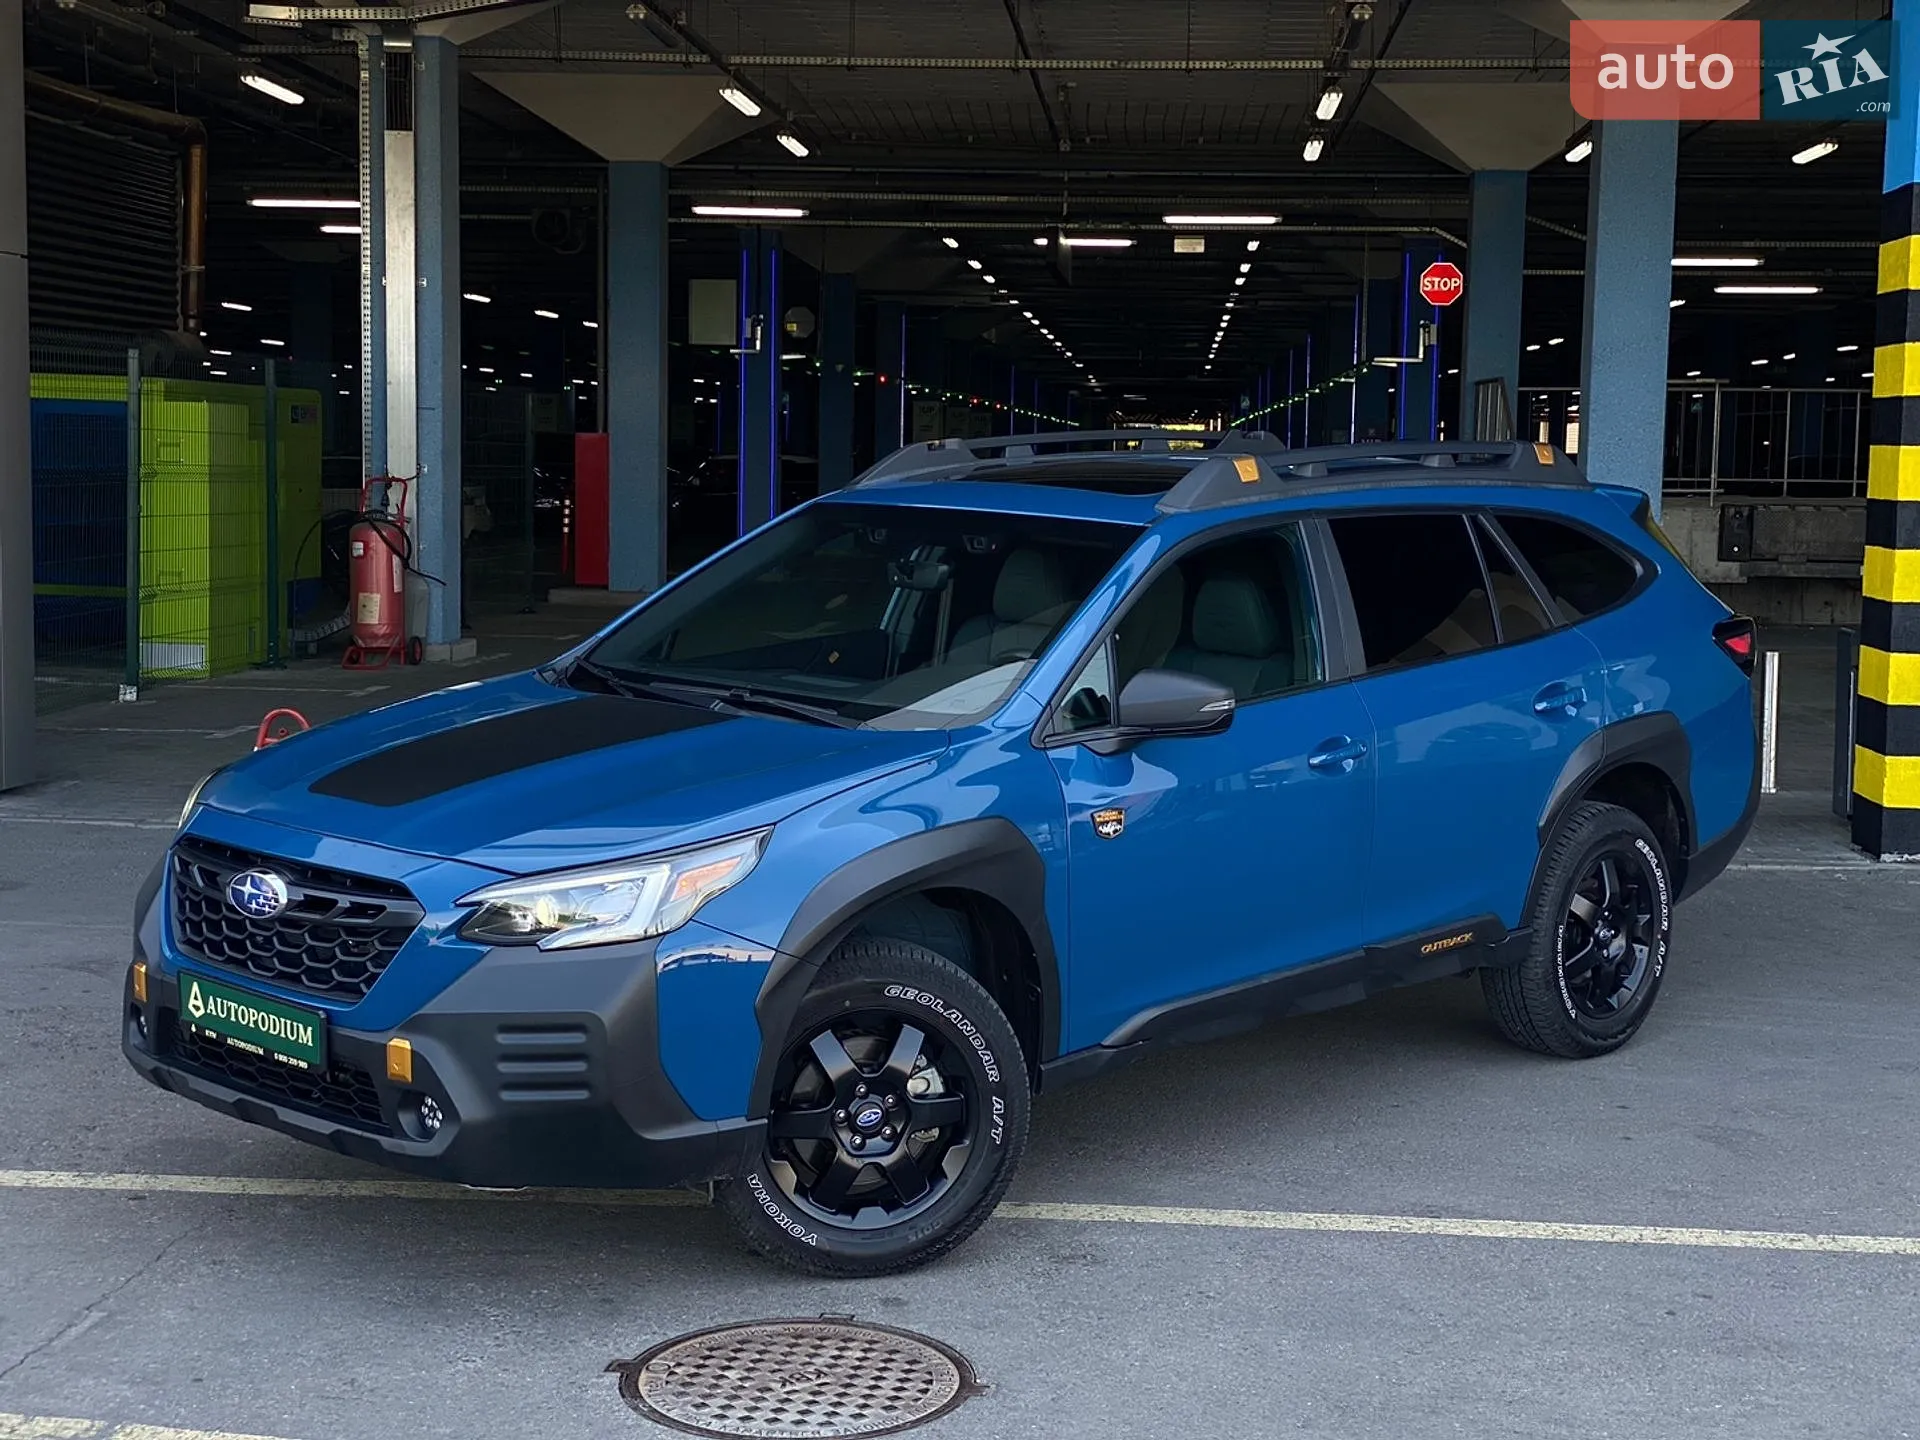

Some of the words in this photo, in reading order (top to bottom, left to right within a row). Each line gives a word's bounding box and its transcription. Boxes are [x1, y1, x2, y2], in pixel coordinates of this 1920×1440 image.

[1423, 277, 1460, 291] STOP
[1421, 932, 1473, 954] OUTBACK
[206, 995, 313, 1047] AUTOPODIUM
[884, 985, 1000, 1083] GEOLANDAR
[991, 1096, 1004, 1145] A/T
